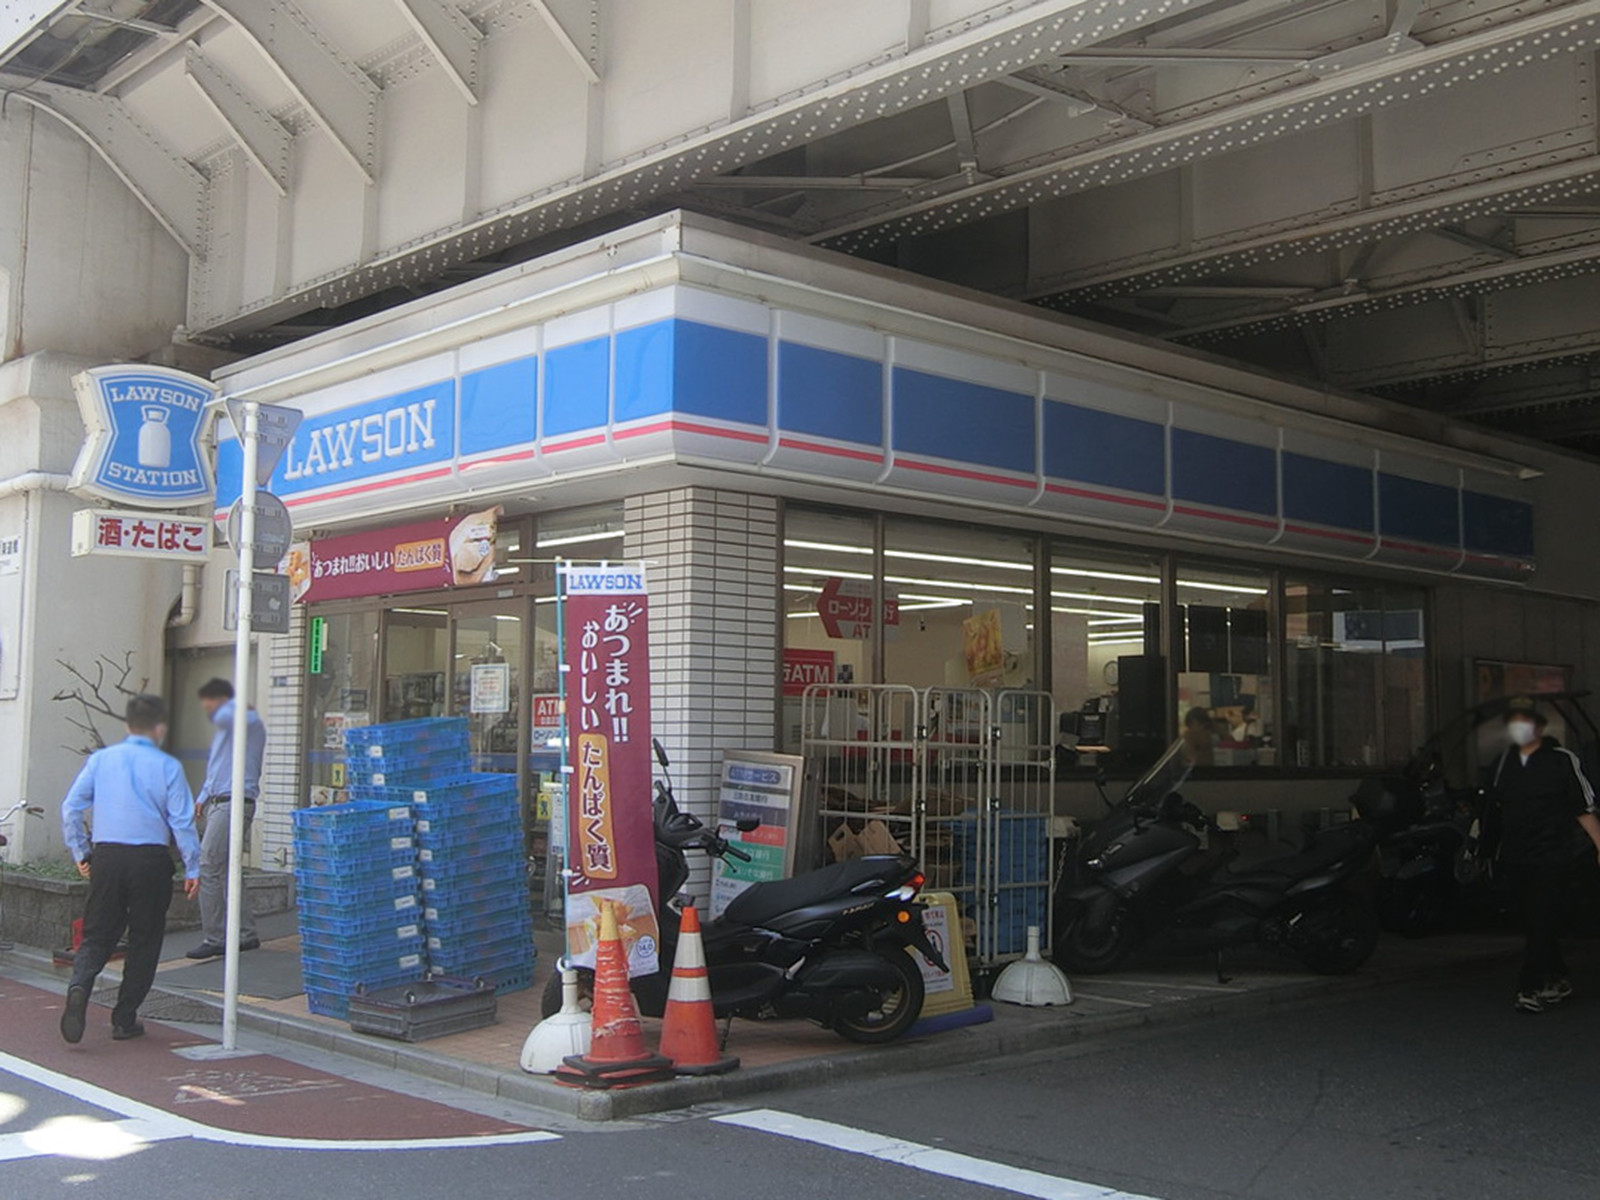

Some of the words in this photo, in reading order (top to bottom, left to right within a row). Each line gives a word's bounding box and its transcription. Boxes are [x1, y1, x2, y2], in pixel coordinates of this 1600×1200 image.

[110, 386, 200, 412] LAWSON
[284, 399, 436, 480] LAWSON
[108, 463, 198, 486] STATION
[98, 517, 203, 552] 酒・たばこ
[569, 574, 642, 590] LAWSON
[828, 599, 895, 620] ローソン行
[581, 620, 600, 730] おいしい
[581, 741, 611, 870] たんぱく質
